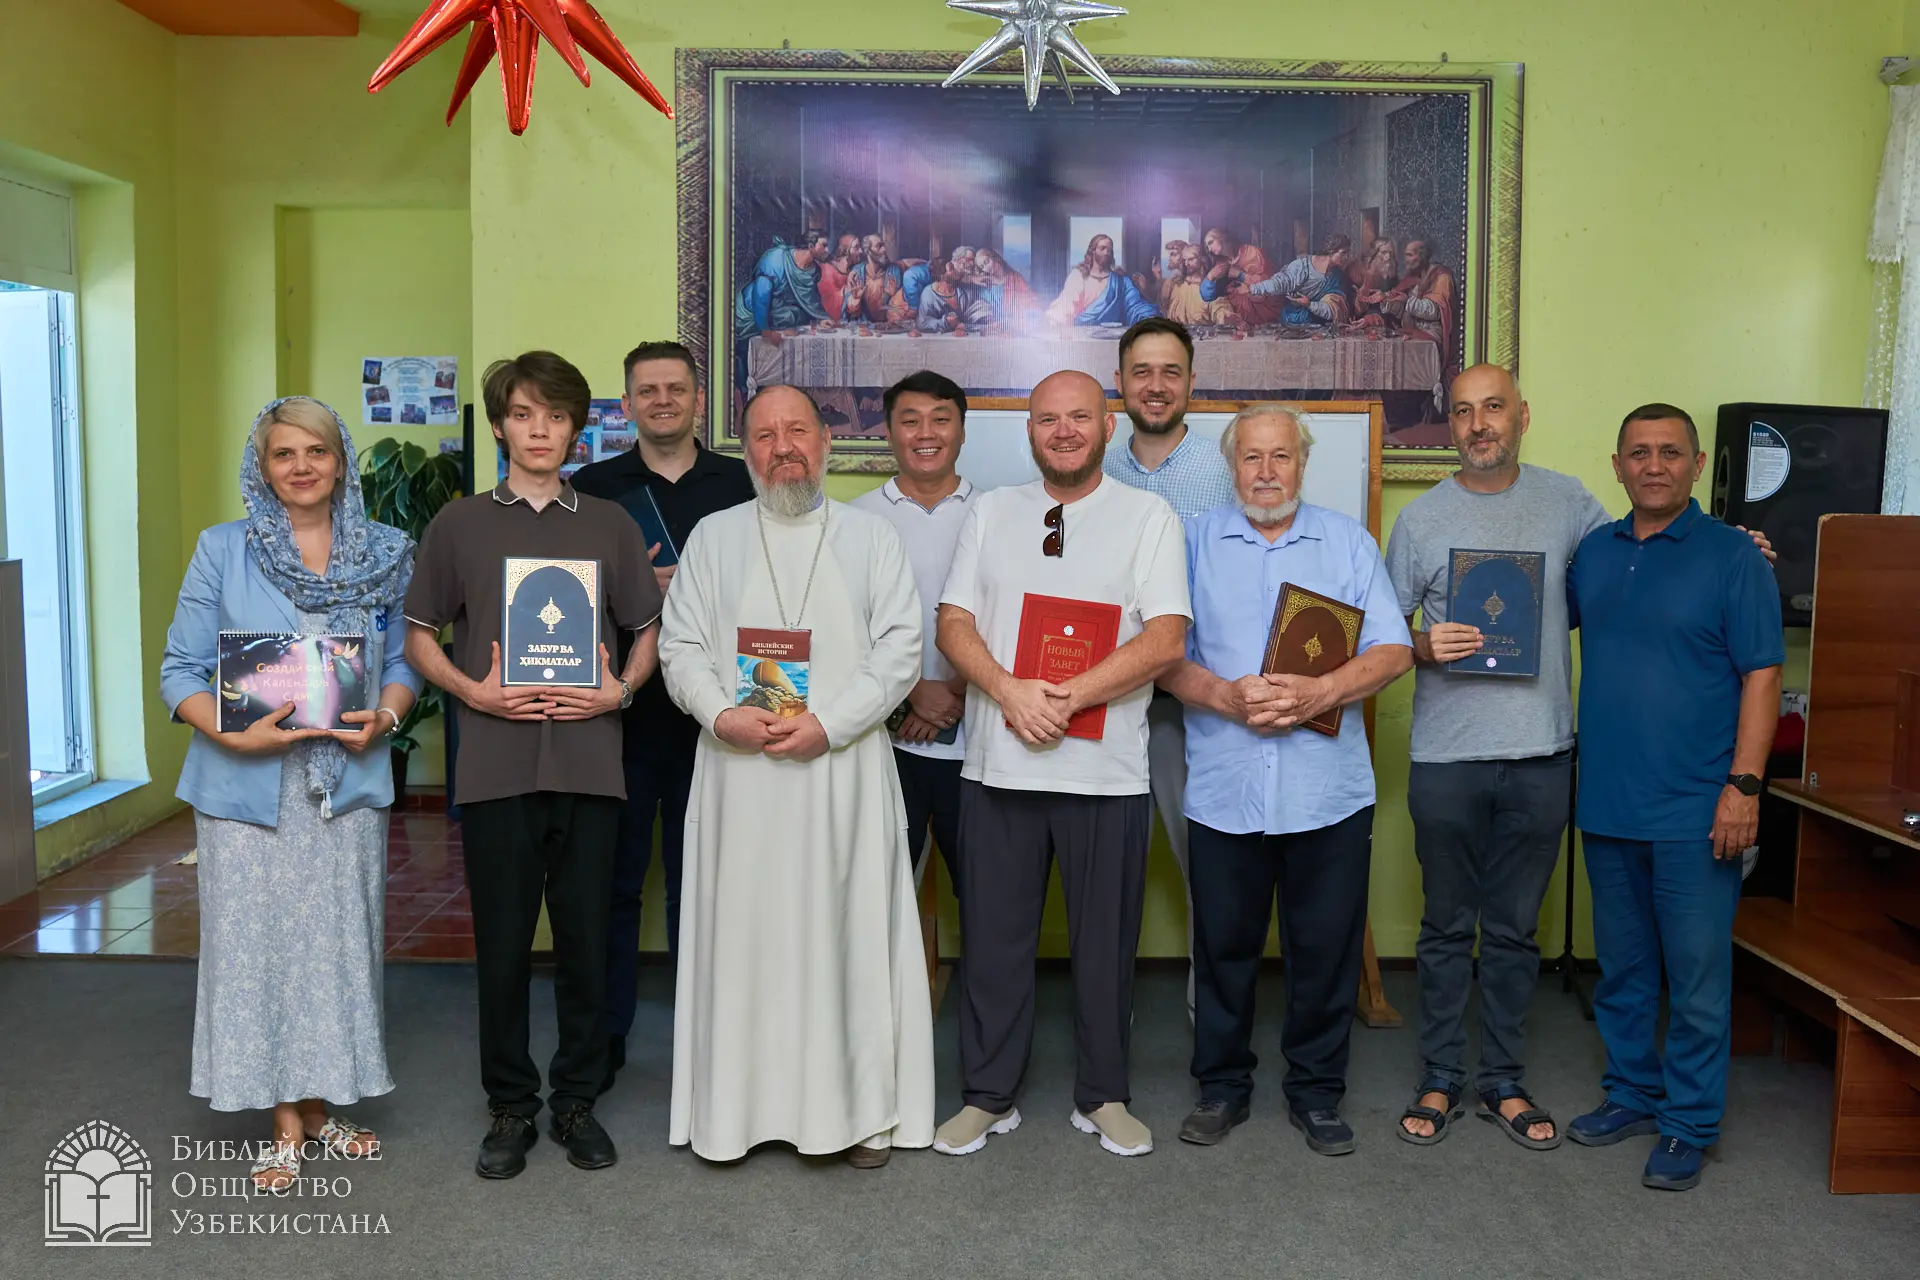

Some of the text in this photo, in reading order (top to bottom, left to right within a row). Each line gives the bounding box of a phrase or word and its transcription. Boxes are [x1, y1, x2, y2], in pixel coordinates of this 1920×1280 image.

[527, 644, 575, 654] ЗАБУР ВА
[751, 642, 794, 650] БИБЛЕЙСКИЕ
[1047, 644, 1086, 659] НОВЫЙ
[519, 656, 582, 667] ҲИКМАТЛАР
[1049, 659, 1081, 671] ЗАВЕТ
